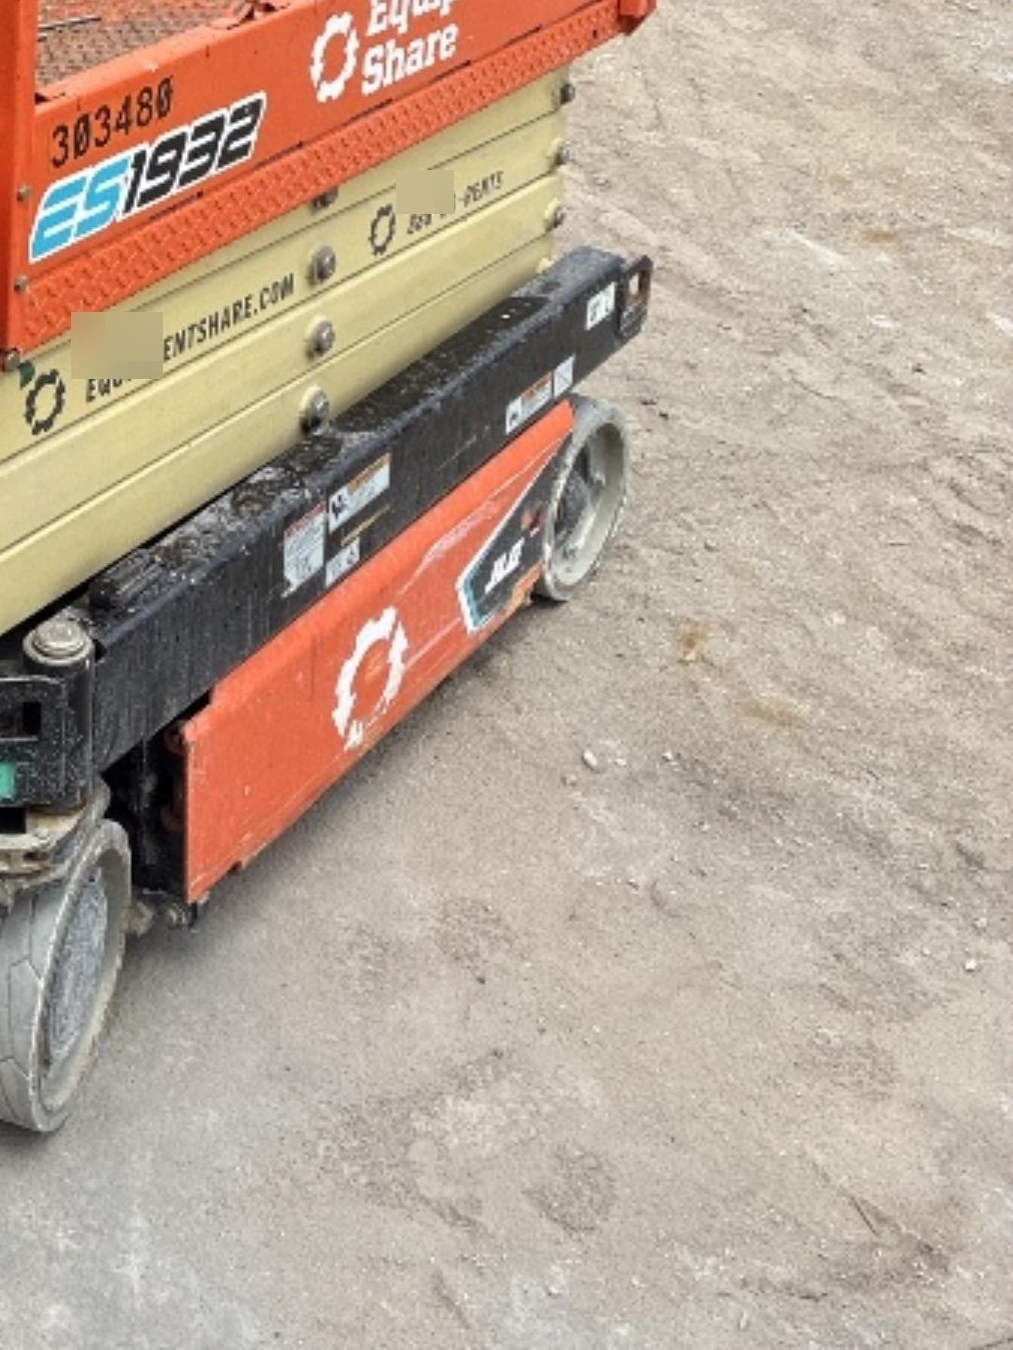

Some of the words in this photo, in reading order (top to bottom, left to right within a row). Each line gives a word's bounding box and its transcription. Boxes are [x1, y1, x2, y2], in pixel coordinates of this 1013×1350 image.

[361, 23, 459, 96] Share
[28, 90, 267, 264] ES1932
[51, 75, 174, 168] 303480
[85, 273, 295, 403] EQENTSHARE.COM
